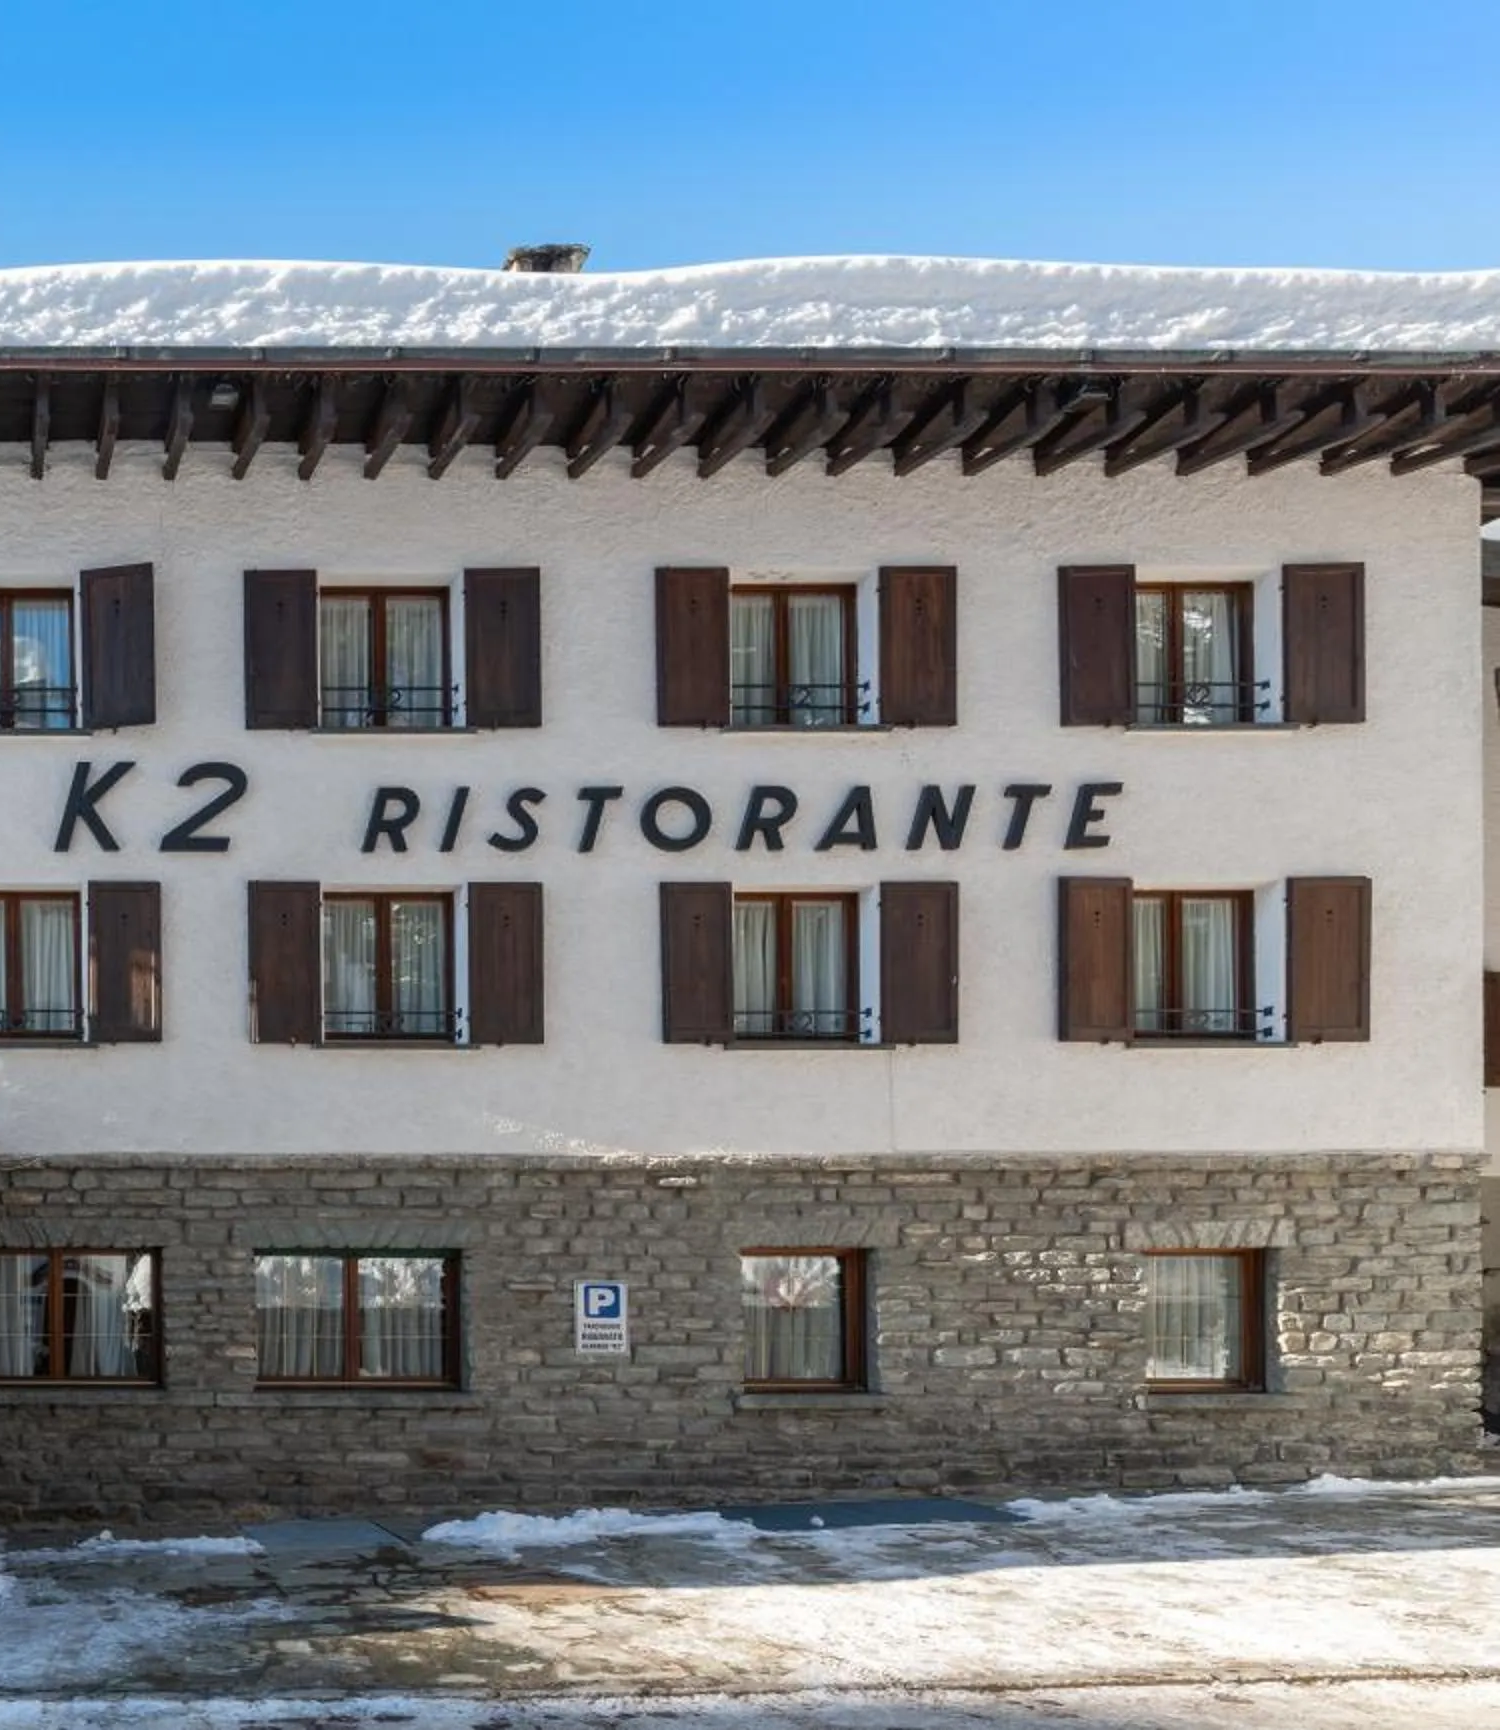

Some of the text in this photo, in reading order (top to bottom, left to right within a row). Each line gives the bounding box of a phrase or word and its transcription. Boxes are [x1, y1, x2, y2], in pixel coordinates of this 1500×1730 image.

[53, 760, 250, 853] K2
[360, 781, 1124, 853] RISTORANTE
[588, 1286, 616, 1316] P
